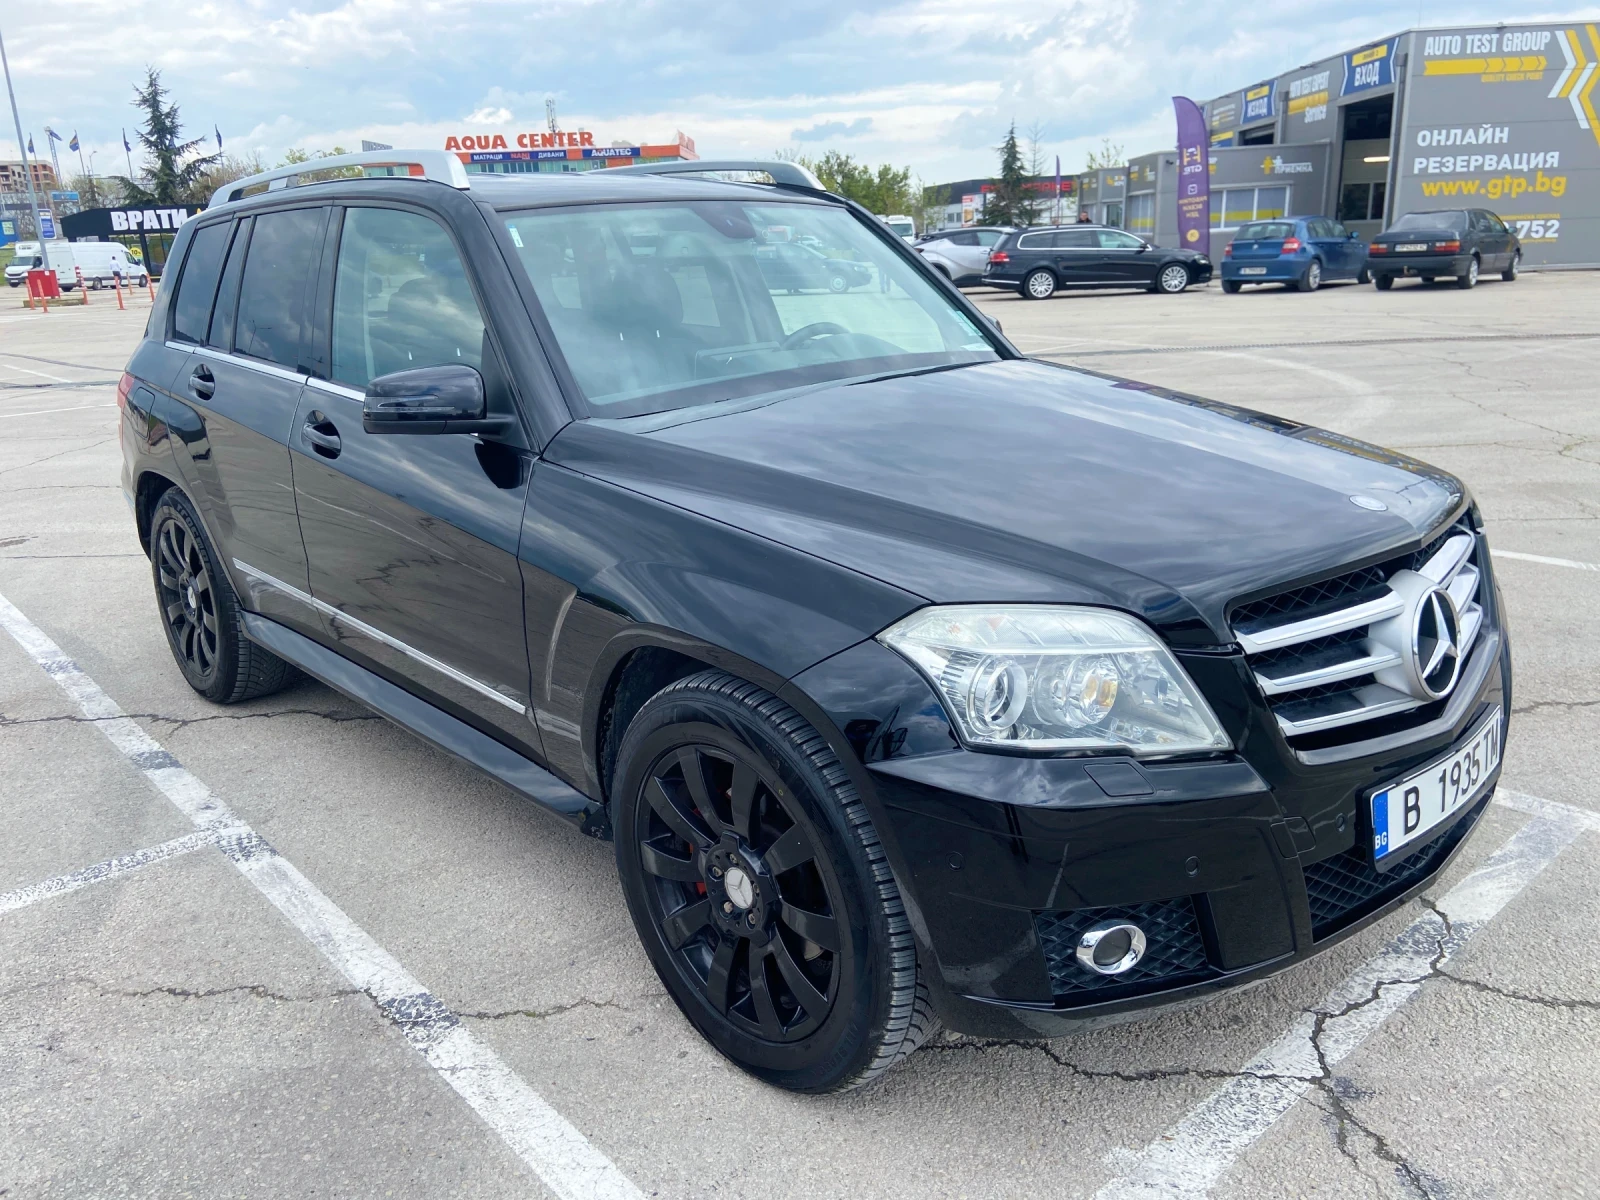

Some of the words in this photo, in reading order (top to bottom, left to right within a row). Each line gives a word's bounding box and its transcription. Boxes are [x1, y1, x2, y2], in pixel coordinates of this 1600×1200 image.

[1424, 35, 1461, 56] AUTO
[1466, 33, 1500, 54] TEST
[1503, 31, 1551, 53] GROUP
[1354, 61, 1380, 87] ВХОД
[445, 134, 508, 150] AQUA
[516, 131, 594, 148] CENTER
[1417, 124, 1509, 147] ОНЛАЙН
[538, 151, 565, 159] ДИВАНИ
[591, 148, 632, 157] AQUATEC
[1413, 151, 1560, 174] РЕЗЕРВАЦИЯ
[1421, 171, 1567, 199] www.gtp.bg
[110, 208, 188, 231] ВРАТИ
[1404, 785, 1421, 836] B
[1438, 740, 1481, 814] 1935
[1483, 717, 1499, 773] TM
[1375, 831, 1388, 850] BG
